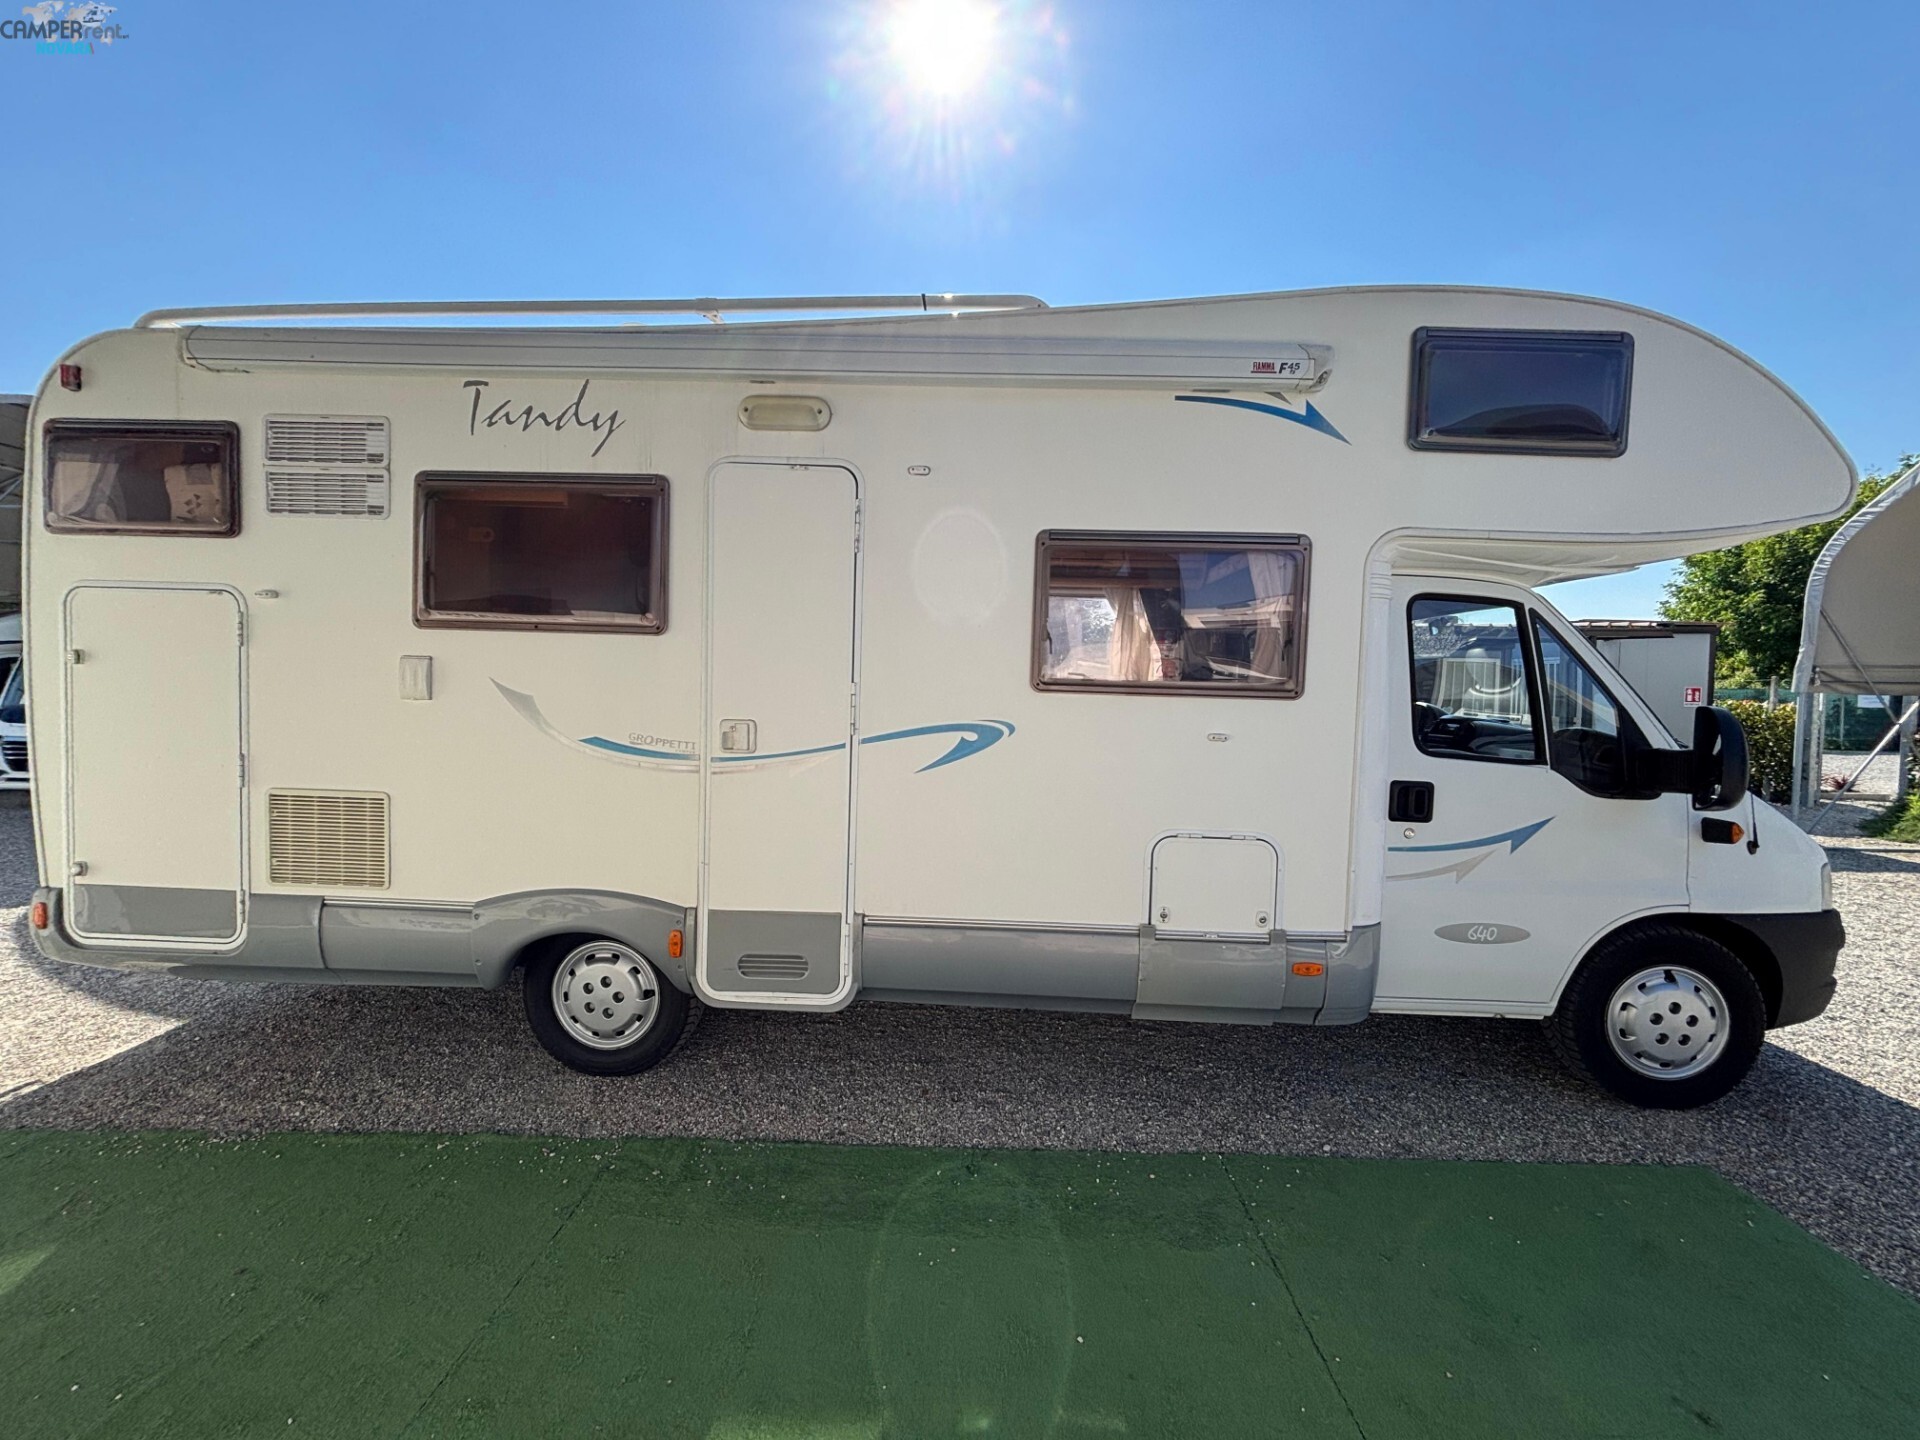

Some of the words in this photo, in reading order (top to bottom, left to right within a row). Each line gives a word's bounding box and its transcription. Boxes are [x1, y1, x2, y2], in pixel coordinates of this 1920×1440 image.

[1252, 361, 1275, 371] FIAMMA
[463, 378, 626, 457] Tandy
[628, 732, 696, 750] GROPPETTI
[1467, 925, 1498, 942] 640
